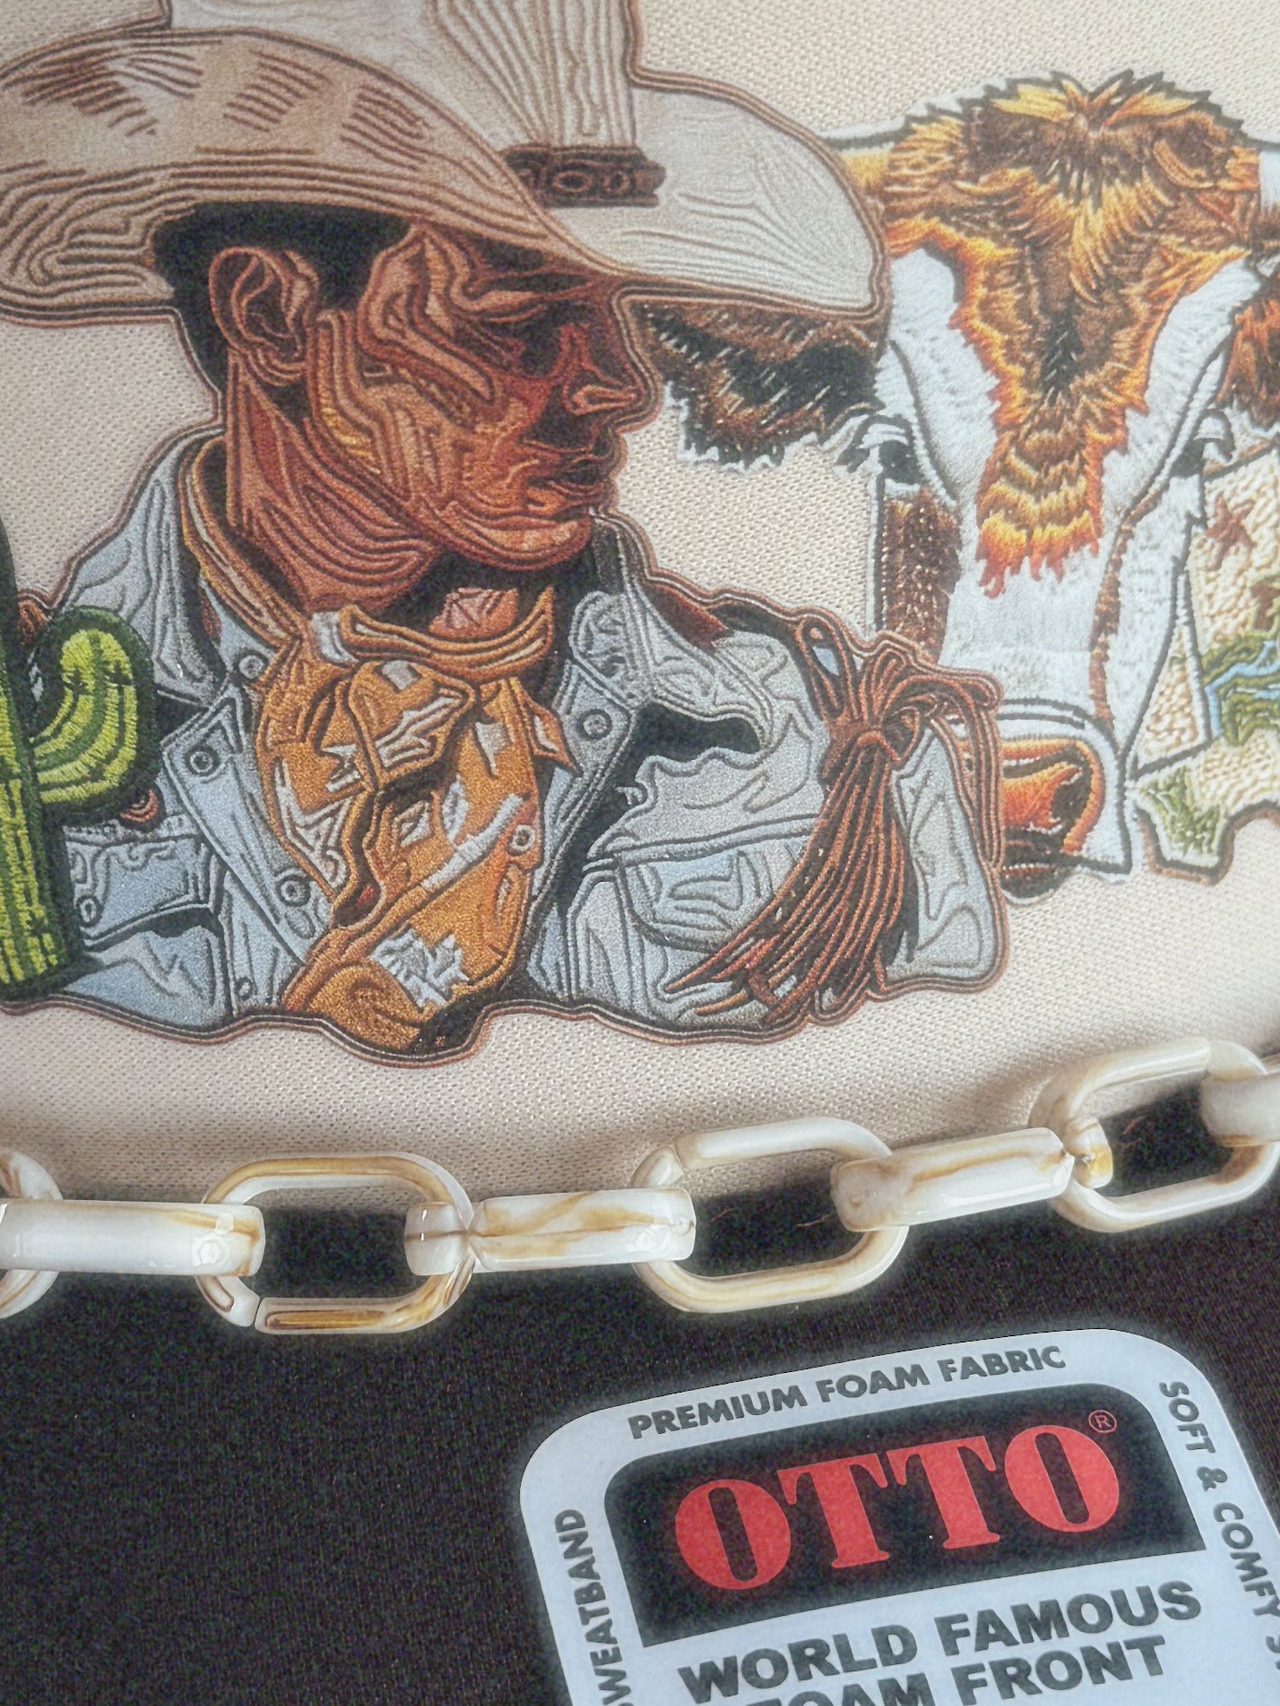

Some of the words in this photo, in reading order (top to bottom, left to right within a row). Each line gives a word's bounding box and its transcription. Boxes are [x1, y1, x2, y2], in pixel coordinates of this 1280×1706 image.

[626, 1384, 809, 1441] PREMIUM
[814, 1363, 931, 1404] FOAM
[937, 1345, 1067, 1383] FABRIC
[1159, 1381, 1216, 1454] SOFT
[1196, 1466, 1228, 1491] &
[676, 1624, 919, 1706] WORLD
[933, 1580, 1202, 1657] FAMOUS
[950, 1634, 1166, 1706] FRONT
